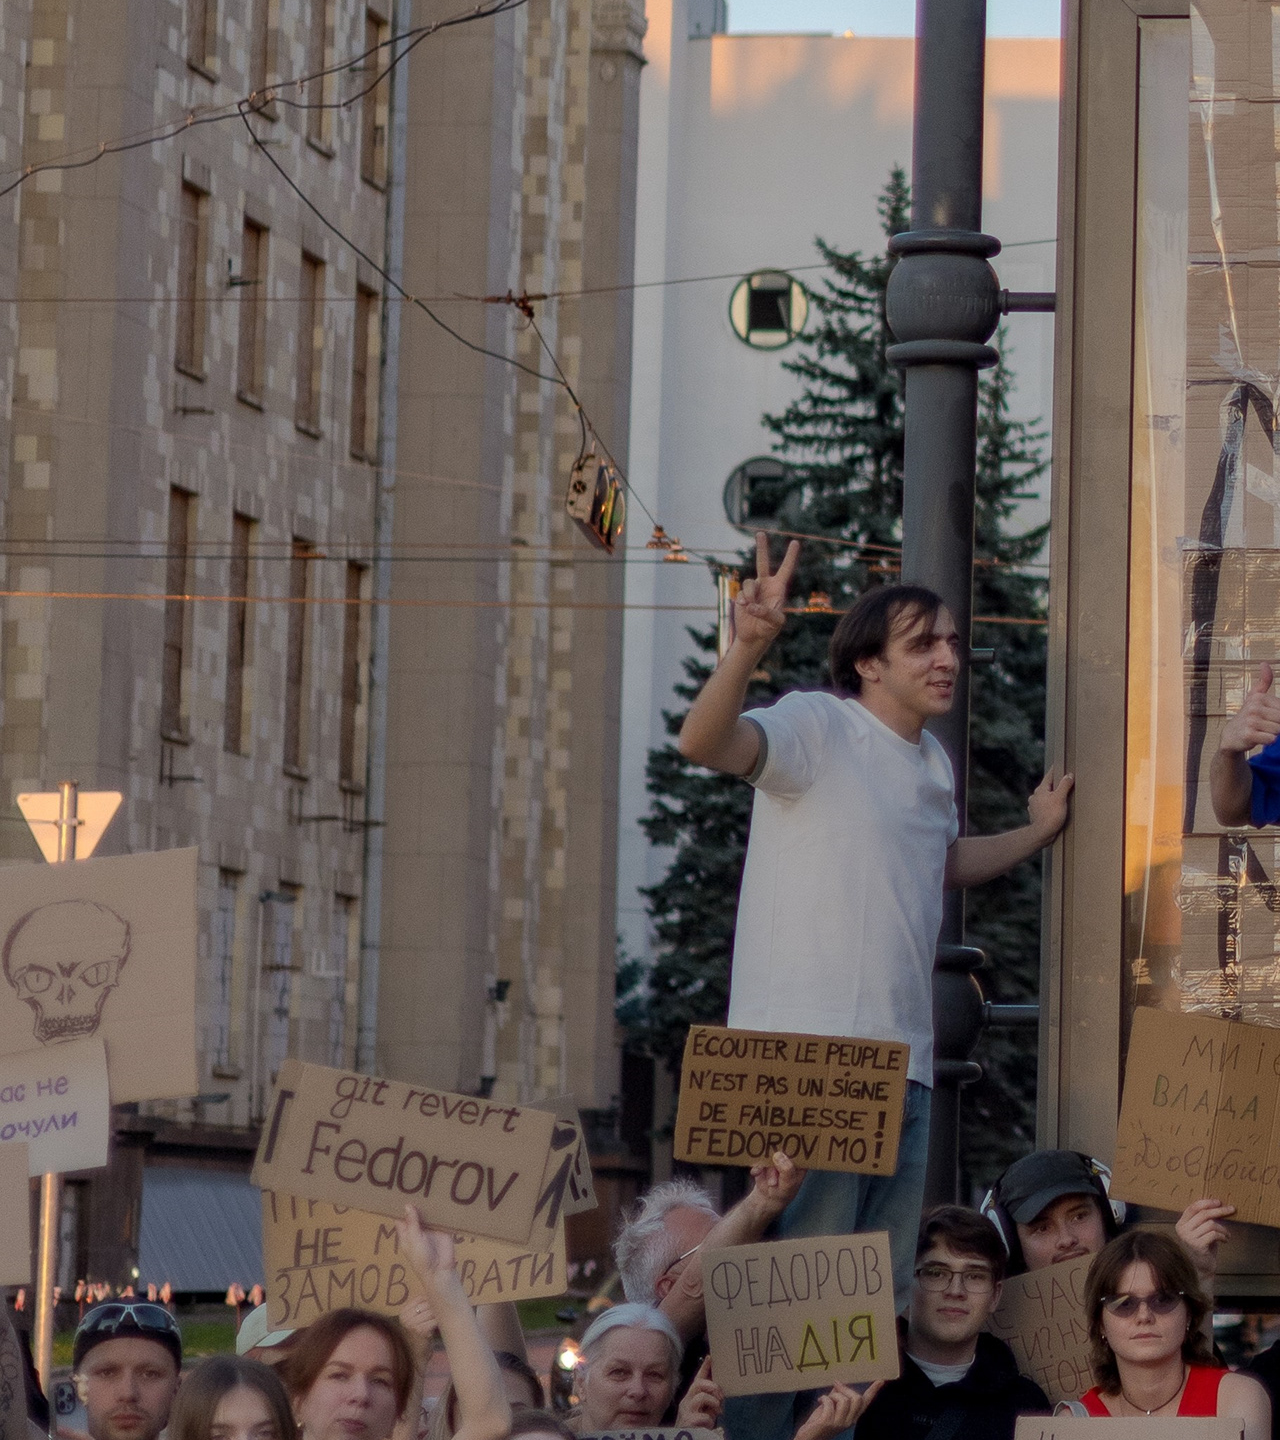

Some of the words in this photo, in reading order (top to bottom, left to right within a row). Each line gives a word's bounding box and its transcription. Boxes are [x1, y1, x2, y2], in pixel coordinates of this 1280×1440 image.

[692, 1029, 788, 1062] ÉCOUTER
[794, 1042, 818, 1063] LE
[825, 1042, 901, 1071] PEUPLE
[1182, 1036, 1240, 1072] МИ
[37, 1075, 69, 1098] не
[689, 1070, 747, 1092] N'EST
[755, 1074, 788, 1095] PAS
[797, 1078, 823, 1097] UN
[1153, 1074, 1259, 1121] ВЛАДА
[0, 1110, 78, 1141] очули
[330, 1077, 389, 1119] git
[402, 1088, 521, 1133] revert
[699, 1102, 728, 1123] DE
[686, 1127, 818, 1160] FEDOROV
[301, 1121, 519, 1211] Fedorov
[294, 1227, 343, 1269] НЕ
[711, 1246, 882, 1309] ФЕДОРОВ
[735, 1315, 877, 1377] НАДІЯ
